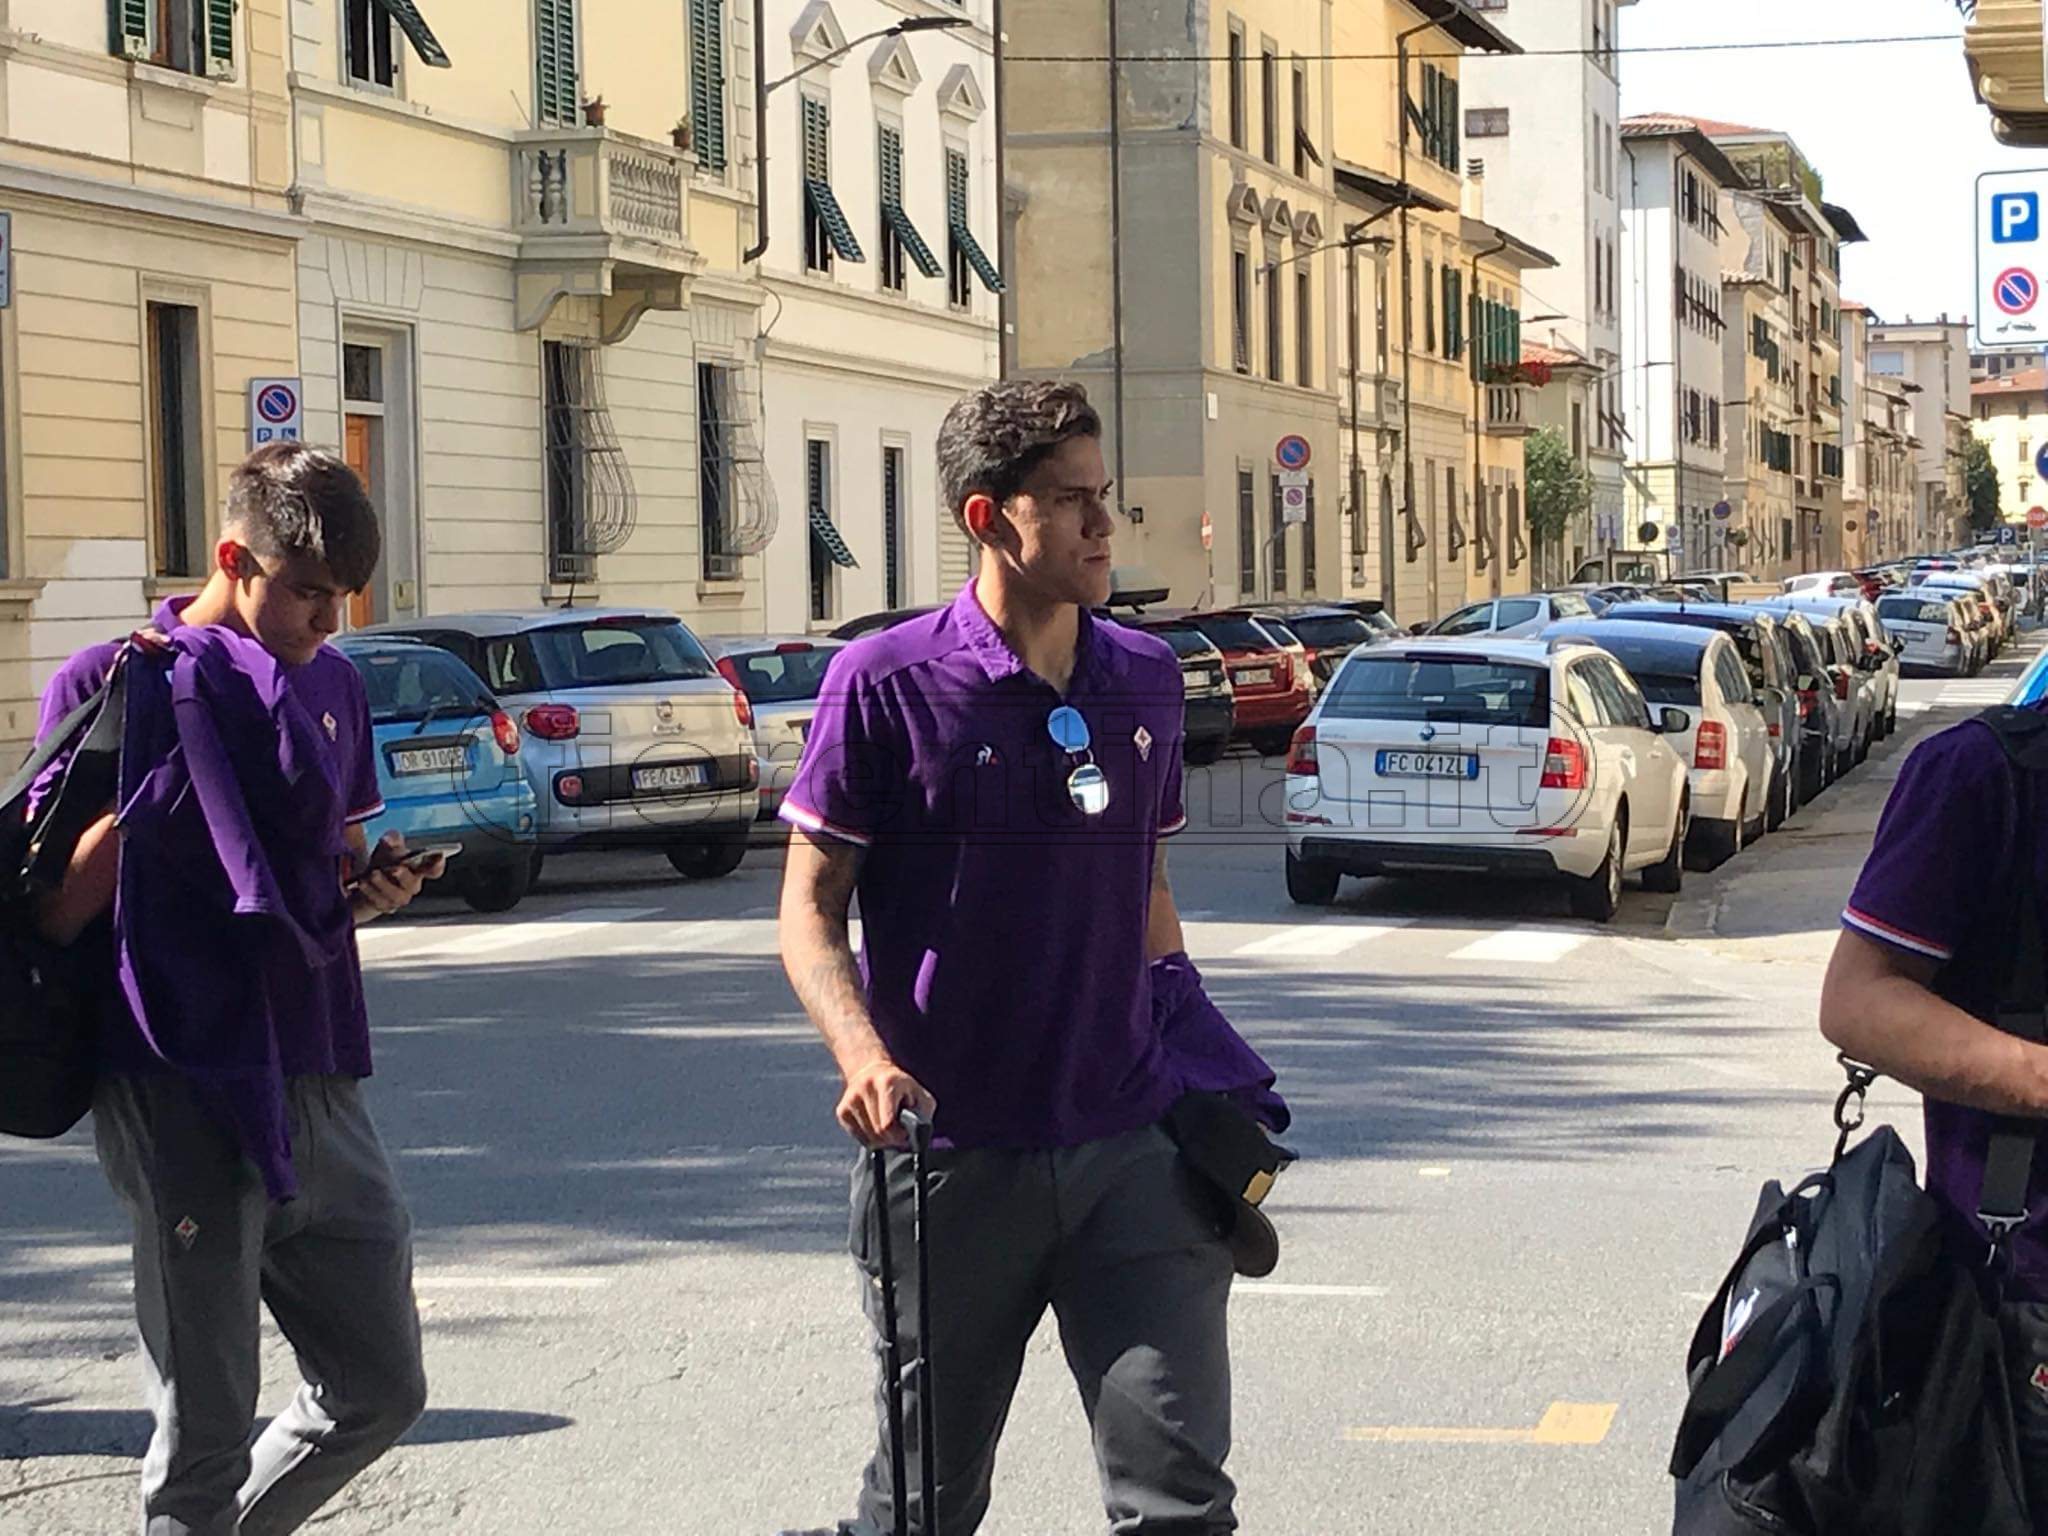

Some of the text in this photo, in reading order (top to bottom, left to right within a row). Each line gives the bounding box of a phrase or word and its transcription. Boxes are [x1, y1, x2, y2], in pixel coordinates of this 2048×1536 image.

[2001, 198, 2030, 238] P
[2001, 528, 2013, 544] P
[1387, 754, 1409, 771] FC
